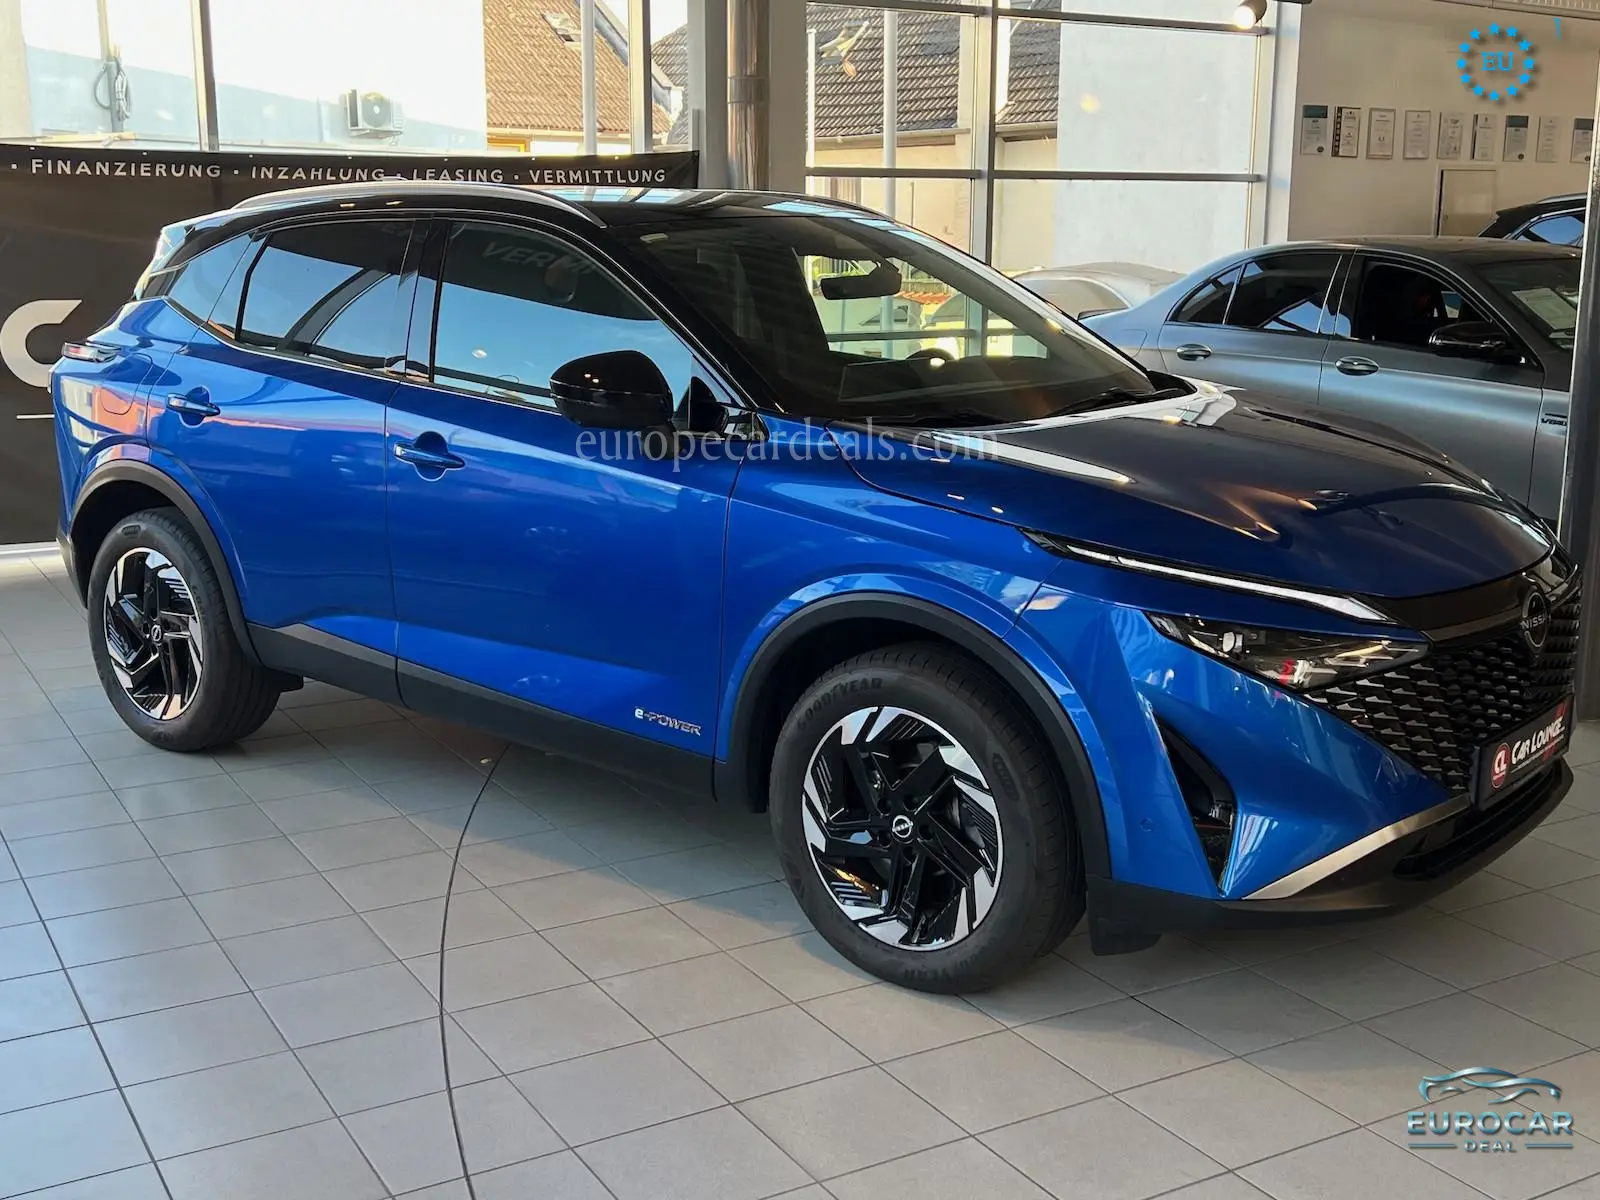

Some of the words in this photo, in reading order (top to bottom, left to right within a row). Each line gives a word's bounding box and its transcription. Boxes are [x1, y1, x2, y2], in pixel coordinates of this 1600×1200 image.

[30, 158, 222, 178] FINANZIERUNG
[251, 165, 386, 181] INZAHLUNG
[412, 168, 504, 183] LEASING
[529, 168, 666, 184] VERMITTLUNG
[634, 706, 702, 737] e-POWER
[1511, 739, 1531, 765] CAR
